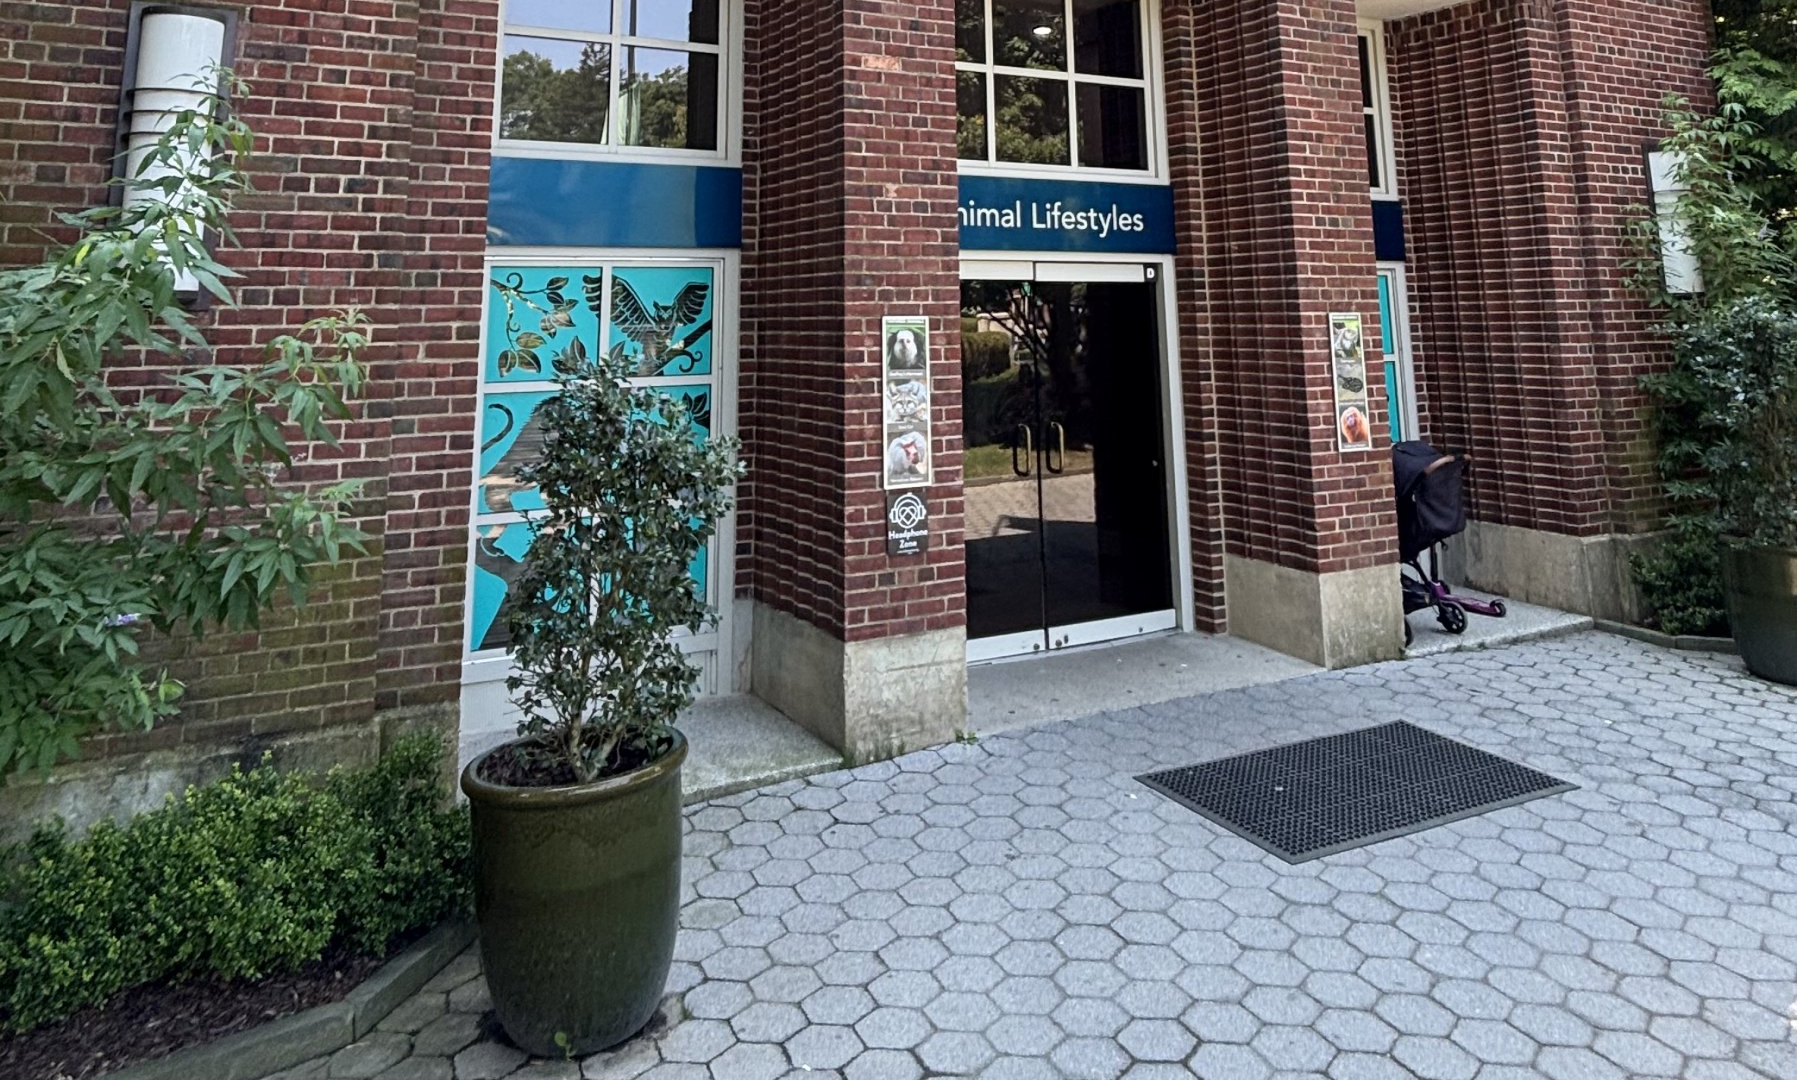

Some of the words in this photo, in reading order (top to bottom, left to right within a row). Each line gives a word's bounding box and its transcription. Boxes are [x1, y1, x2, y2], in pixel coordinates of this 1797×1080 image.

[1031, 201, 1145, 238] Lifestyles
[1146, 267, 1155, 279] D
[888, 528, 929, 540] Headphone
[899, 539, 918, 549] Zone
